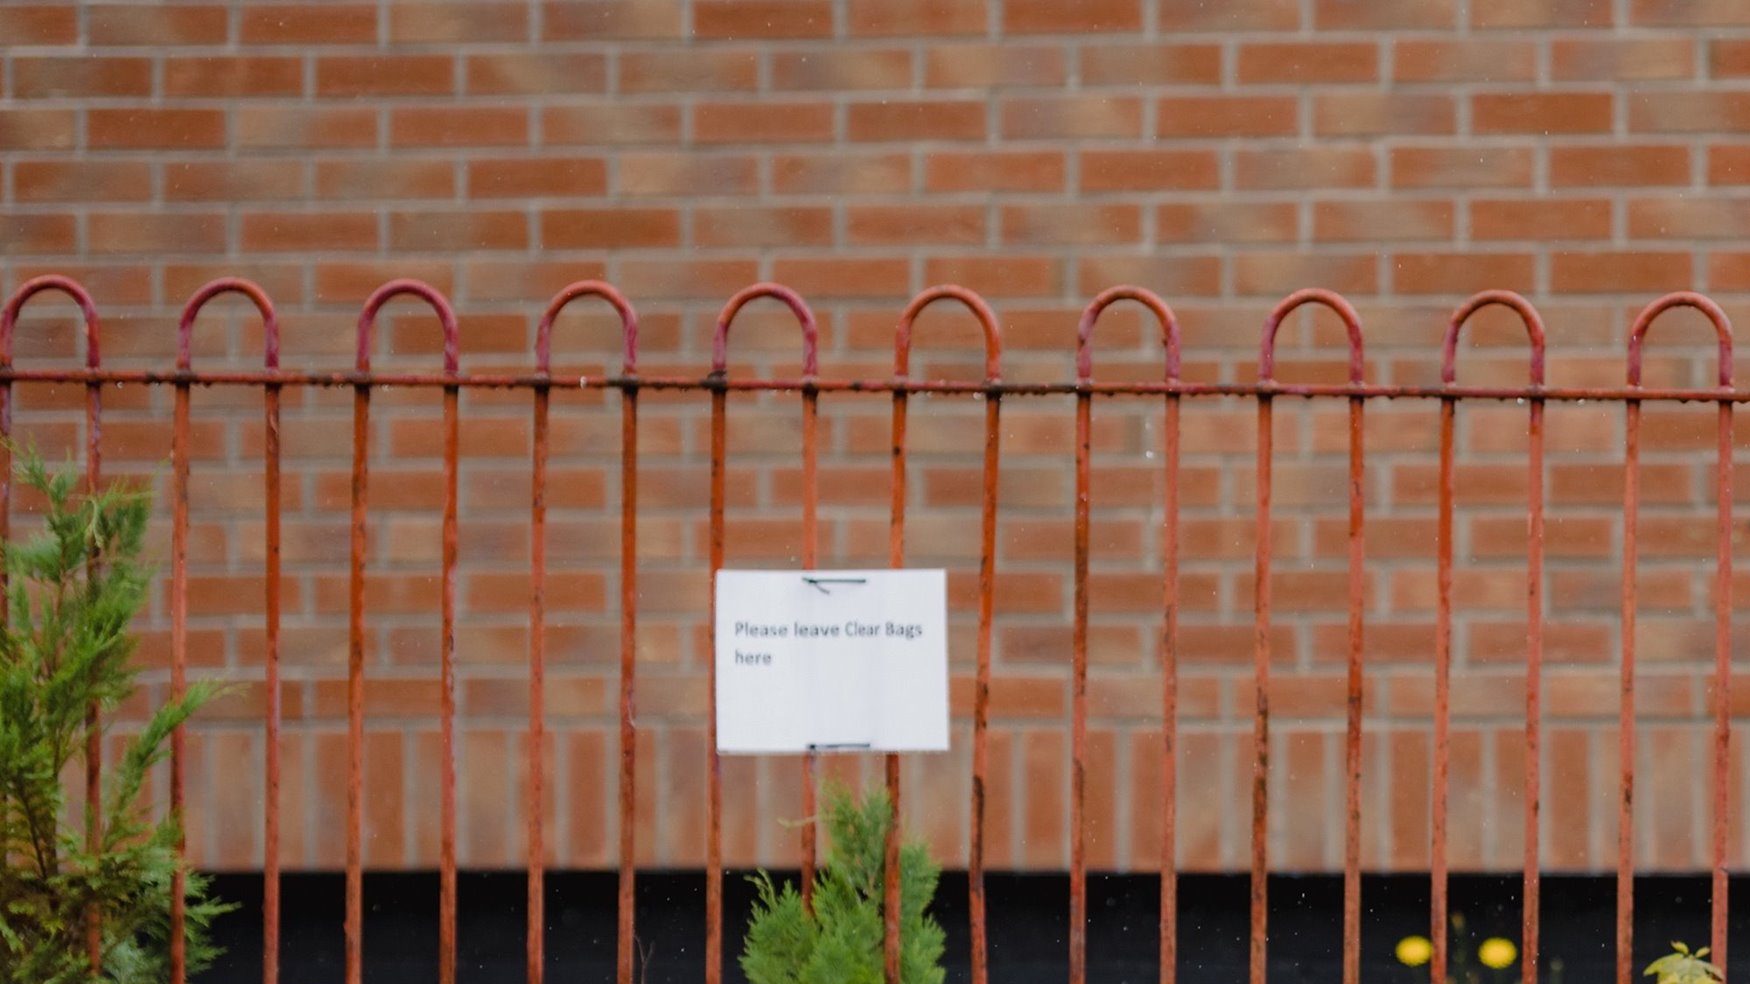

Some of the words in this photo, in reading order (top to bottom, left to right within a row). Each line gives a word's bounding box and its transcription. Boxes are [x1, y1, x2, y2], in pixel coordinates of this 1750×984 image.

[734, 621, 788, 637] Please
[794, 621, 840, 637] leave
[845, 621, 880, 637] Clear
[885, 621, 923, 639] Bags
[734, 649, 772, 665] here
